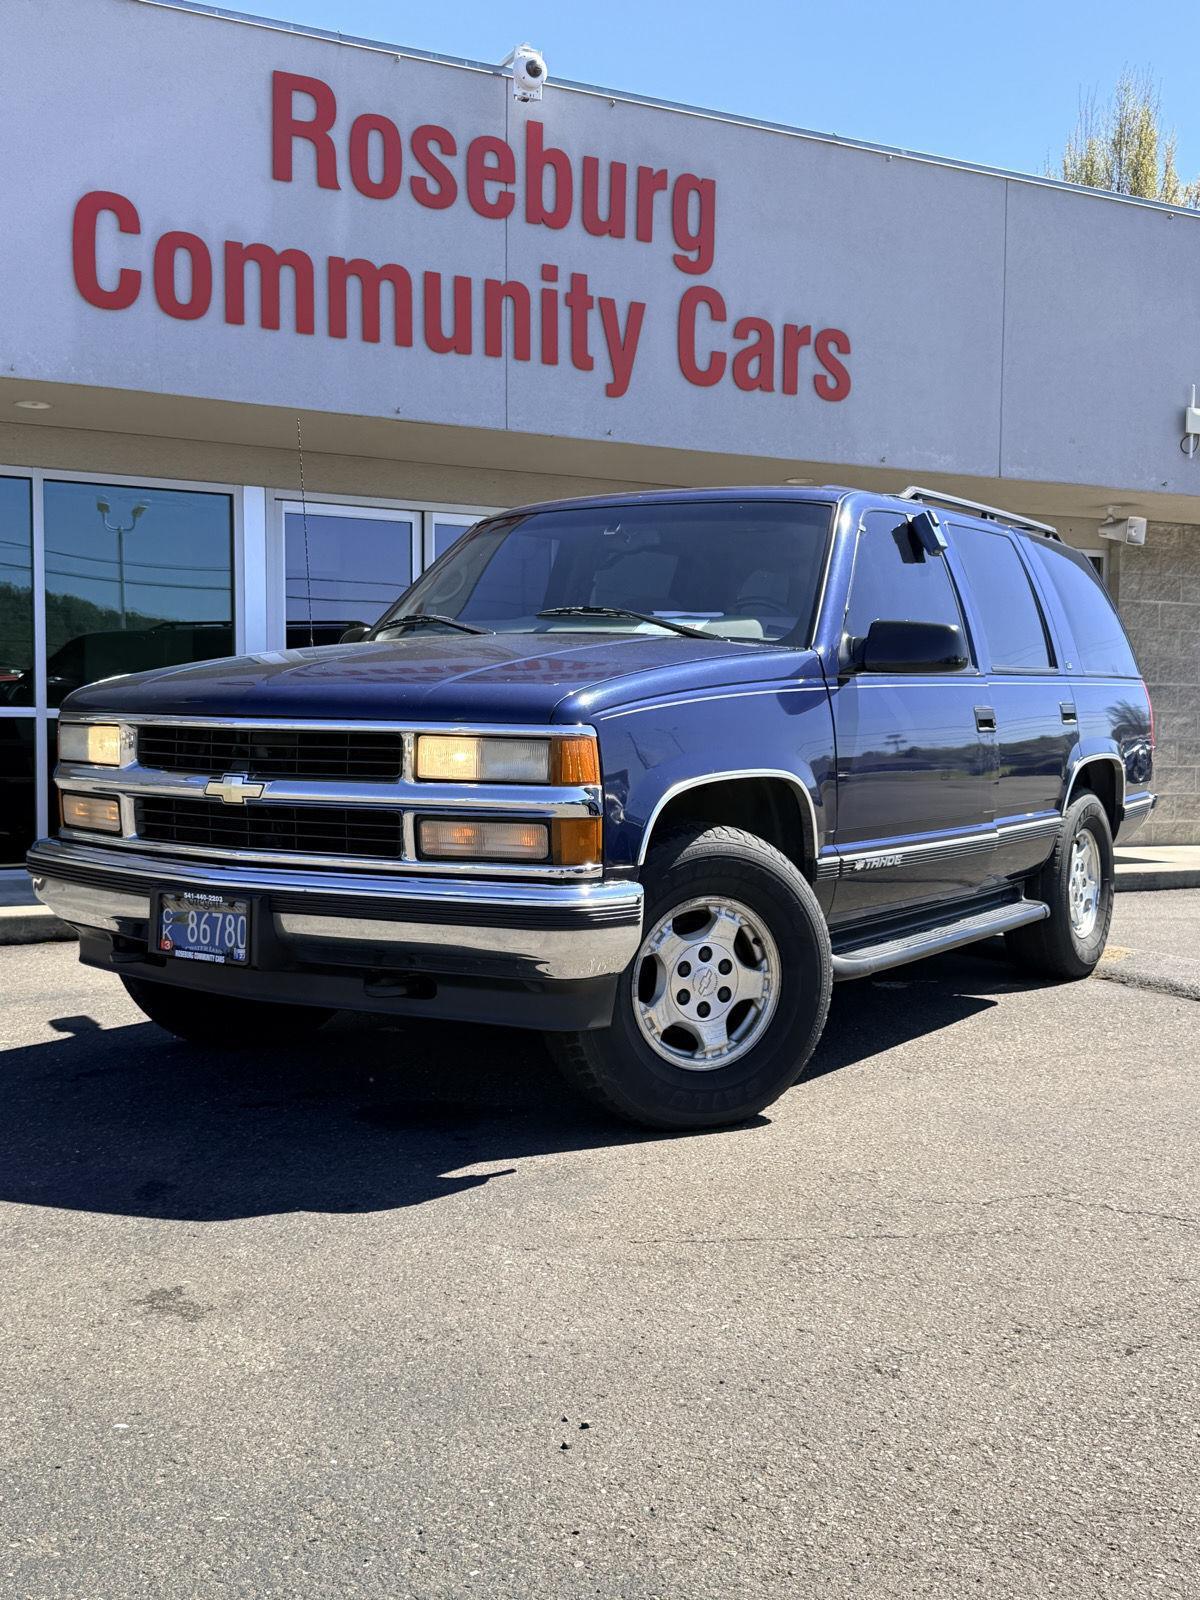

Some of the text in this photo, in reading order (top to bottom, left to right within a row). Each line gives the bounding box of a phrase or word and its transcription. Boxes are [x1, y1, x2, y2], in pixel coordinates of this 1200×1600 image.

[272, 70, 717, 275] Roseburg
[72, 190, 852, 402] Community Cars
[865, 855, 903, 869] TAHOE
[187, 911, 247, 948] 86780
